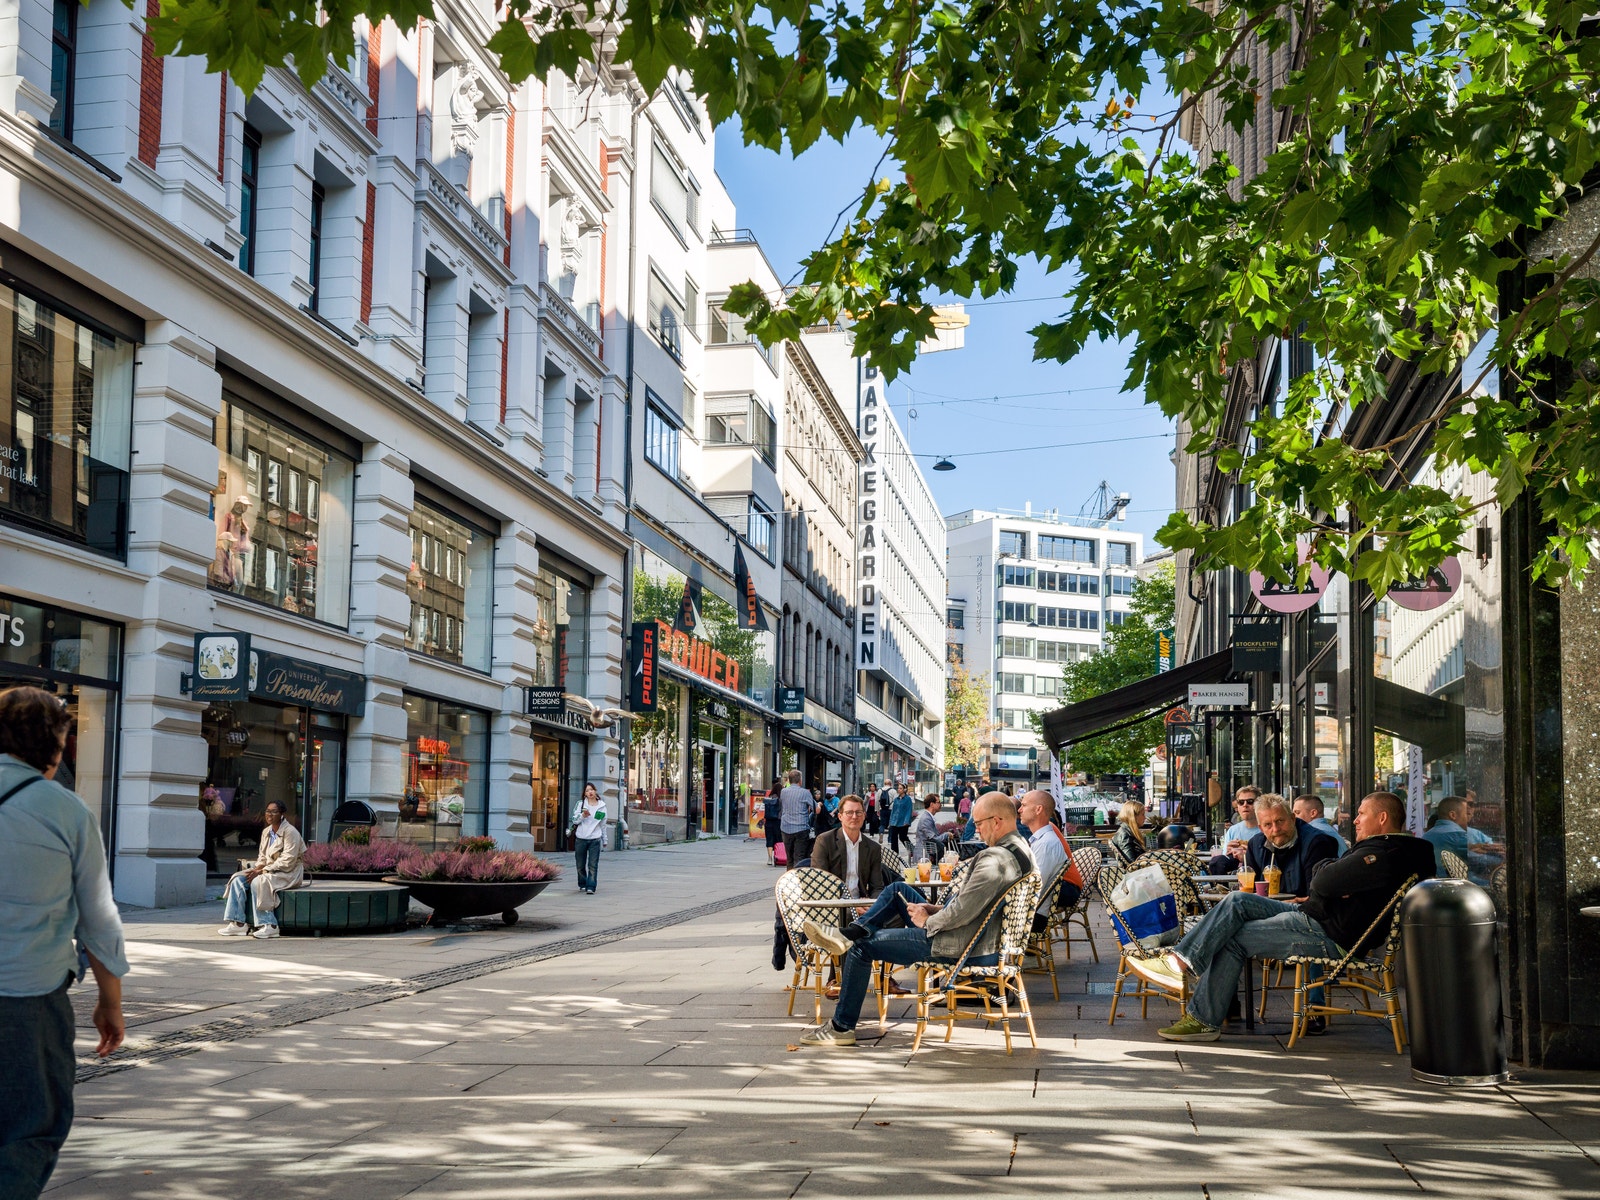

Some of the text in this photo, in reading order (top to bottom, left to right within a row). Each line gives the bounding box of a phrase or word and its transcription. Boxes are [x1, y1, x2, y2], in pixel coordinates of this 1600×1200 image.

[20, 466, 38, 488] last
[642, 629, 653, 705] POWER
[655, 618, 740, 692] POWER
[265, 667, 343, 707] Presentkort
[288, 670, 322, 684] UNIVERSAL
